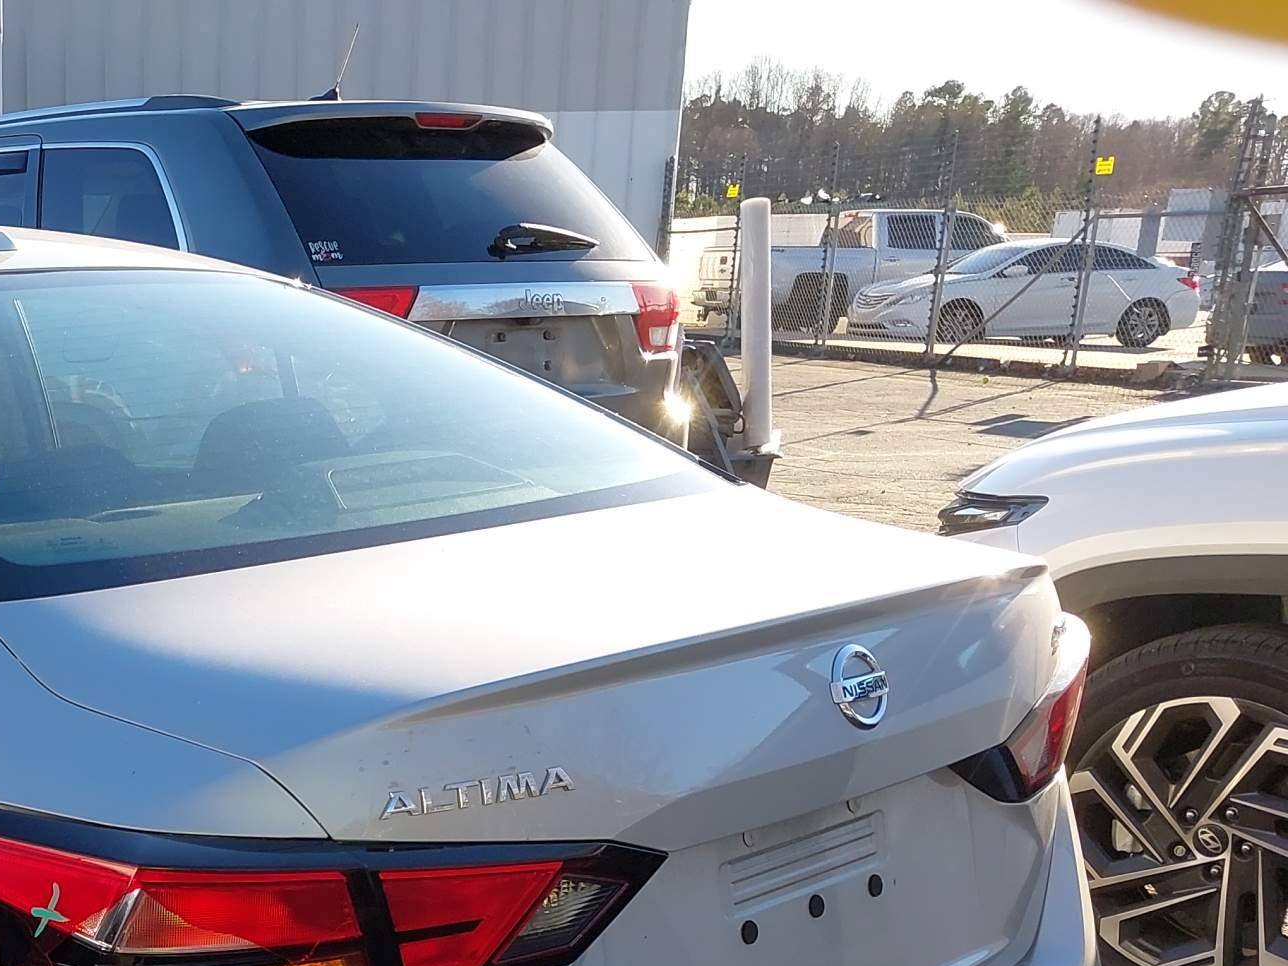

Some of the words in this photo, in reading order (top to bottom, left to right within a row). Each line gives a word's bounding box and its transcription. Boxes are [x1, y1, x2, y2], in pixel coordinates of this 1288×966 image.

[519, 288, 564, 312] Jeep
[842, 674, 889, 699] NISSAN
[379, 765, 576, 820] ALTIMA
